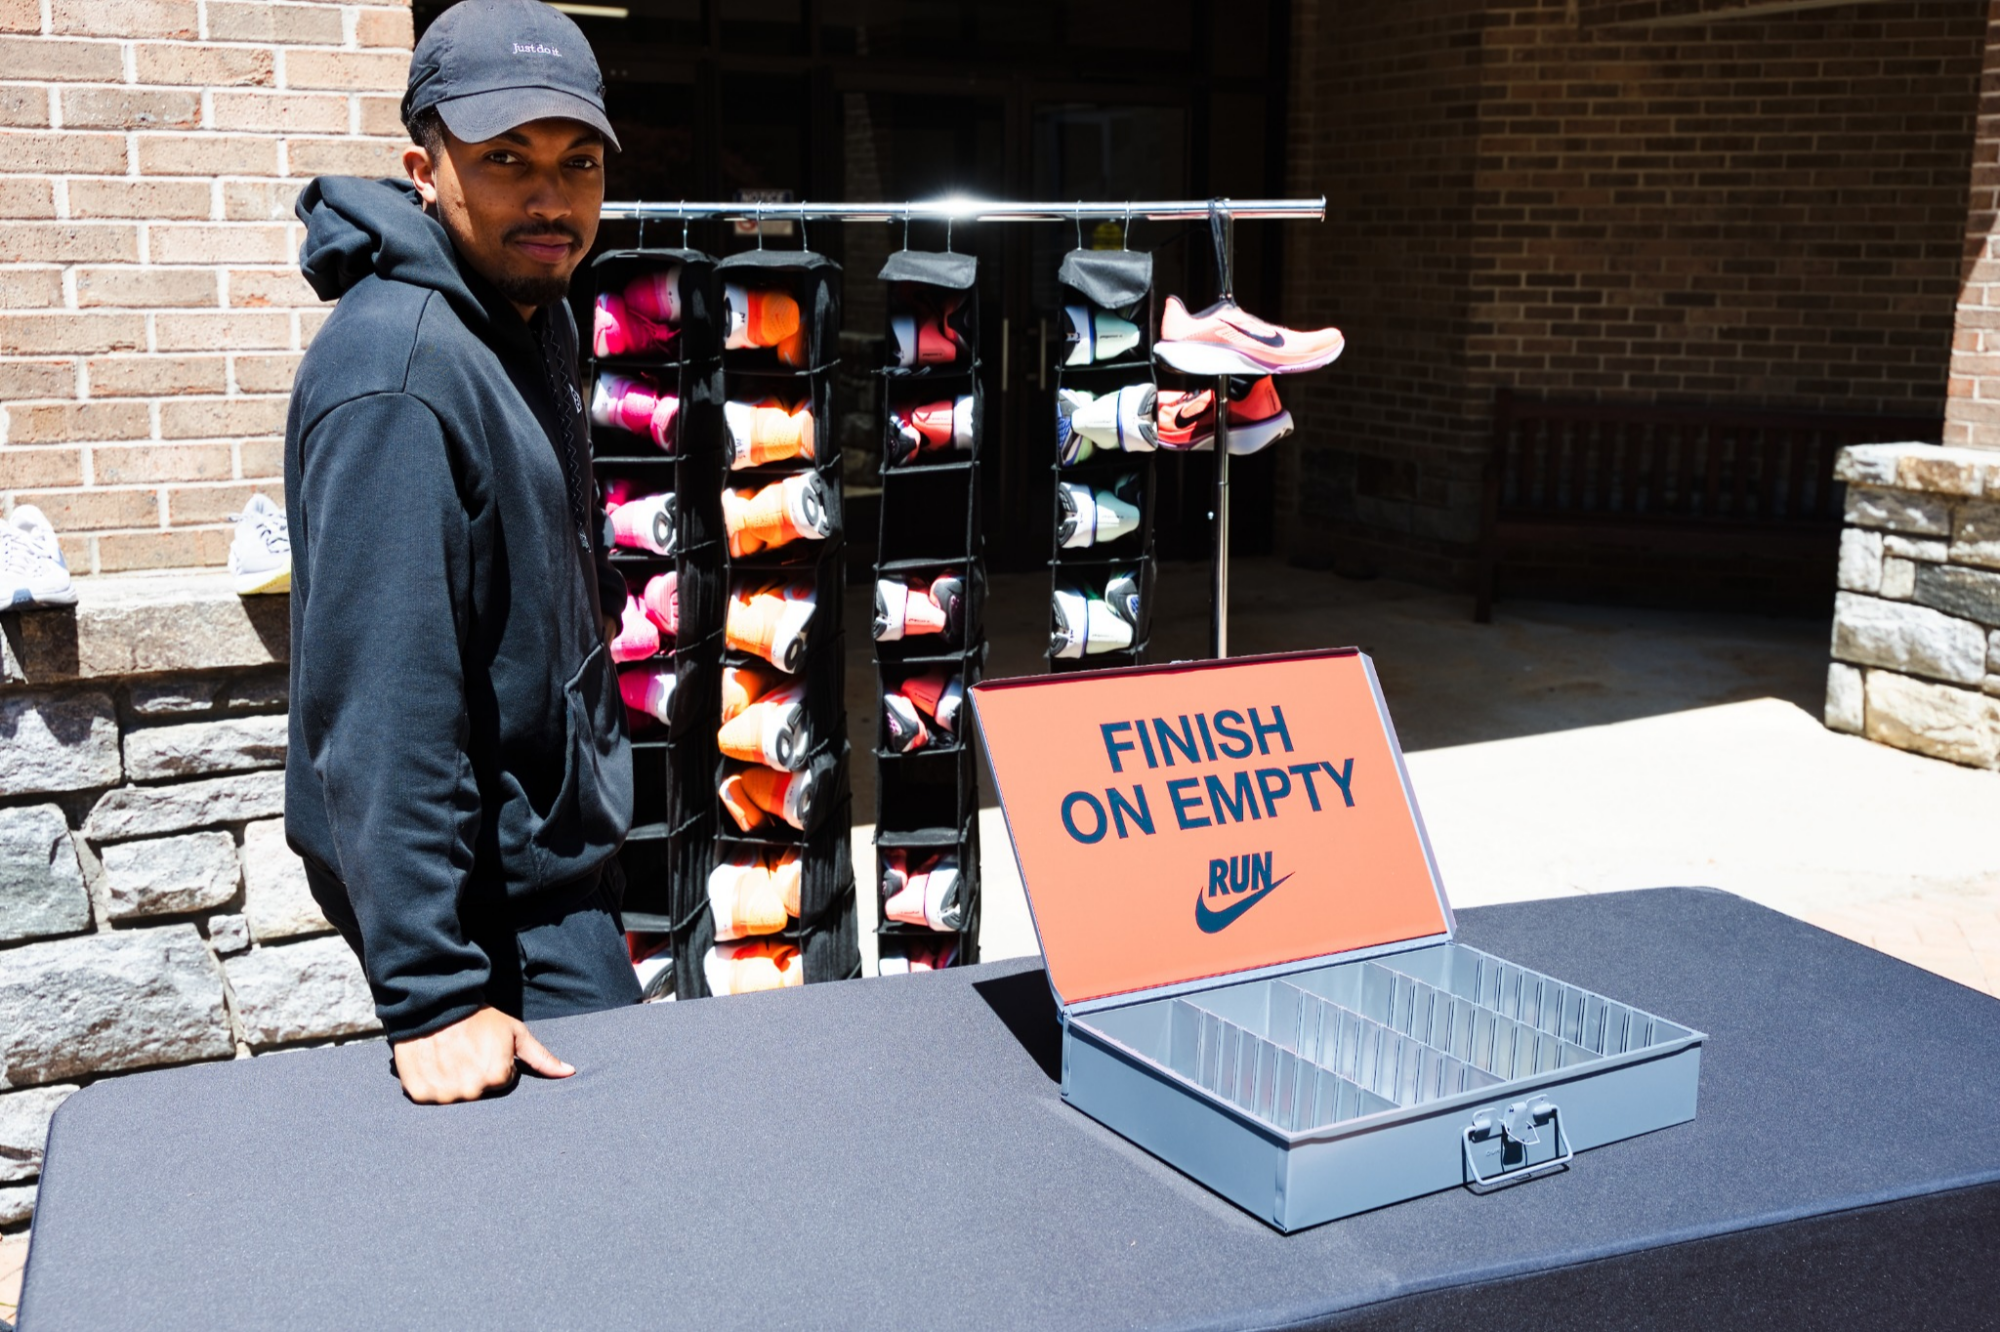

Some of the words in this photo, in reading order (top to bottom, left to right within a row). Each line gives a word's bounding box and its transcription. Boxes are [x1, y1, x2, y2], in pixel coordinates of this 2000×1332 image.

[512, 43, 536, 54] Just
[537, 44, 550, 54] do
[1100, 705, 1294, 773] FINISH
[1061, 784, 1156, 845] ON
[1166, 758, 1355, 831] EMPTY
[1208, 851, 1273, 898] RUN
